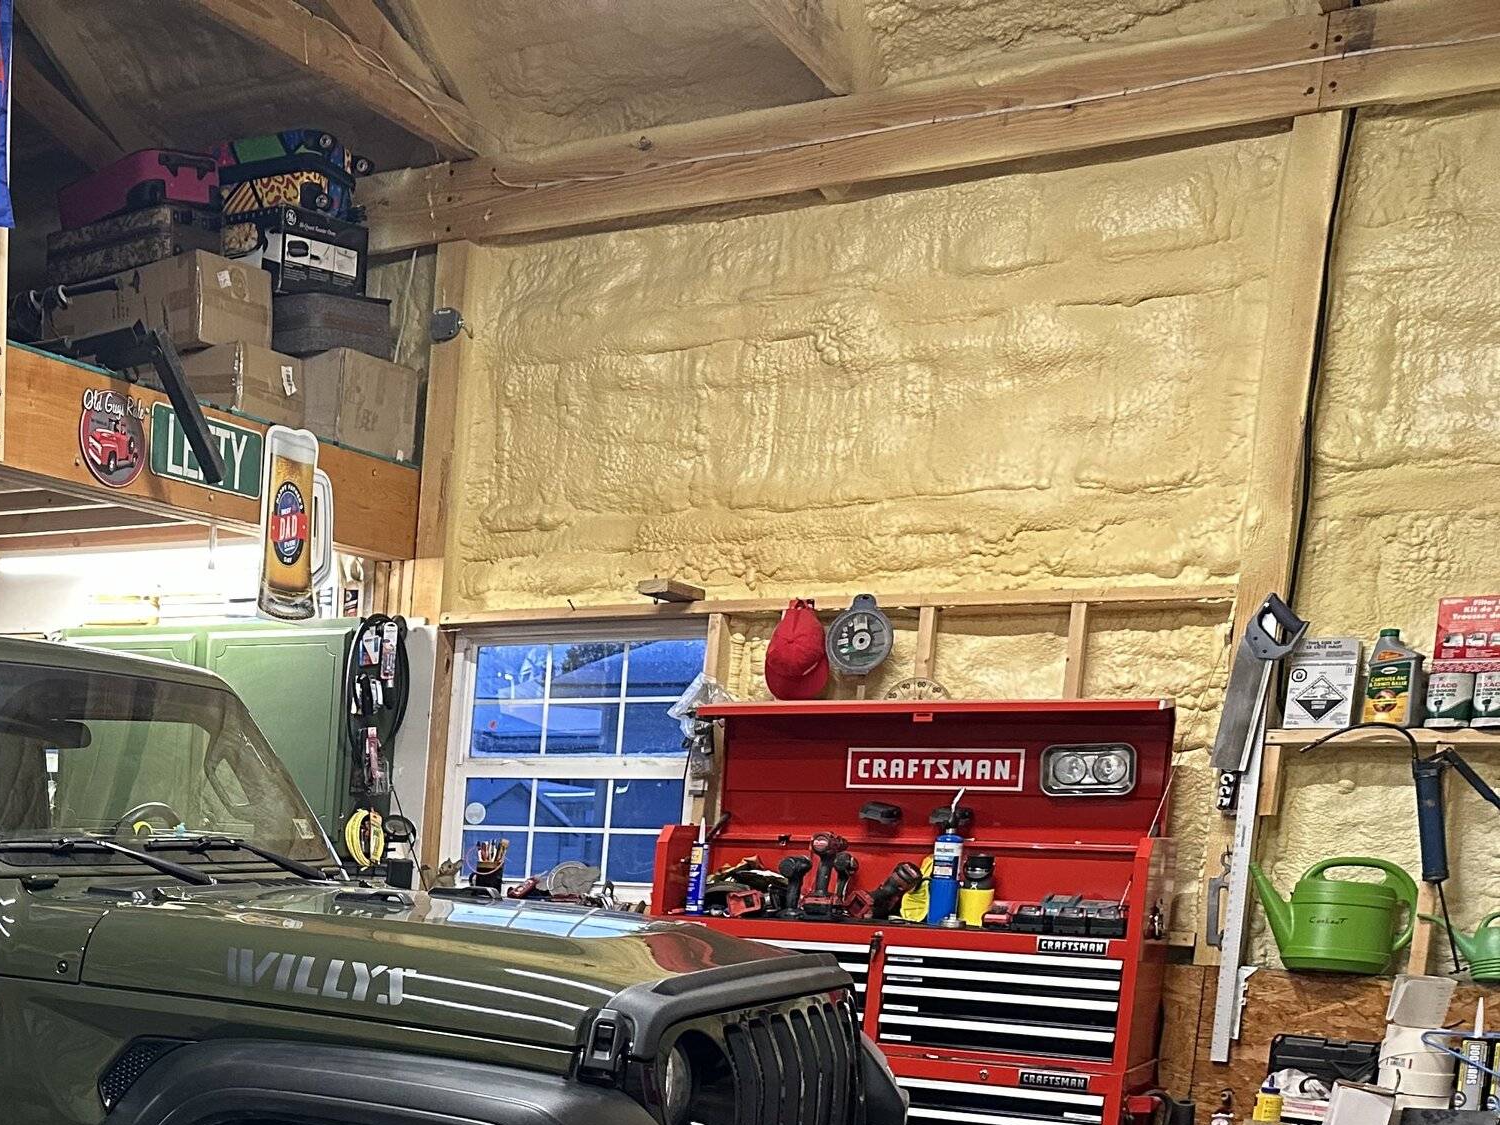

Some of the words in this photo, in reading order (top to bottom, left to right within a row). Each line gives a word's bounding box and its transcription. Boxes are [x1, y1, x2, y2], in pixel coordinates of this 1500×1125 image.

[83, 388, 103, 412] Old
[104, 394, 125, 420] Guys
[167, 413, 248, 490] LETY
[279, 515, 298, 540] DAD
[901, 682, 911, 690] 40
[857, 758, 1011, 780] CRAFTSMAN
[1041, 940, 1104, 953] CRAFTSMAN
[1023, 1074, 1086, 1088] CRAFTSMAN
